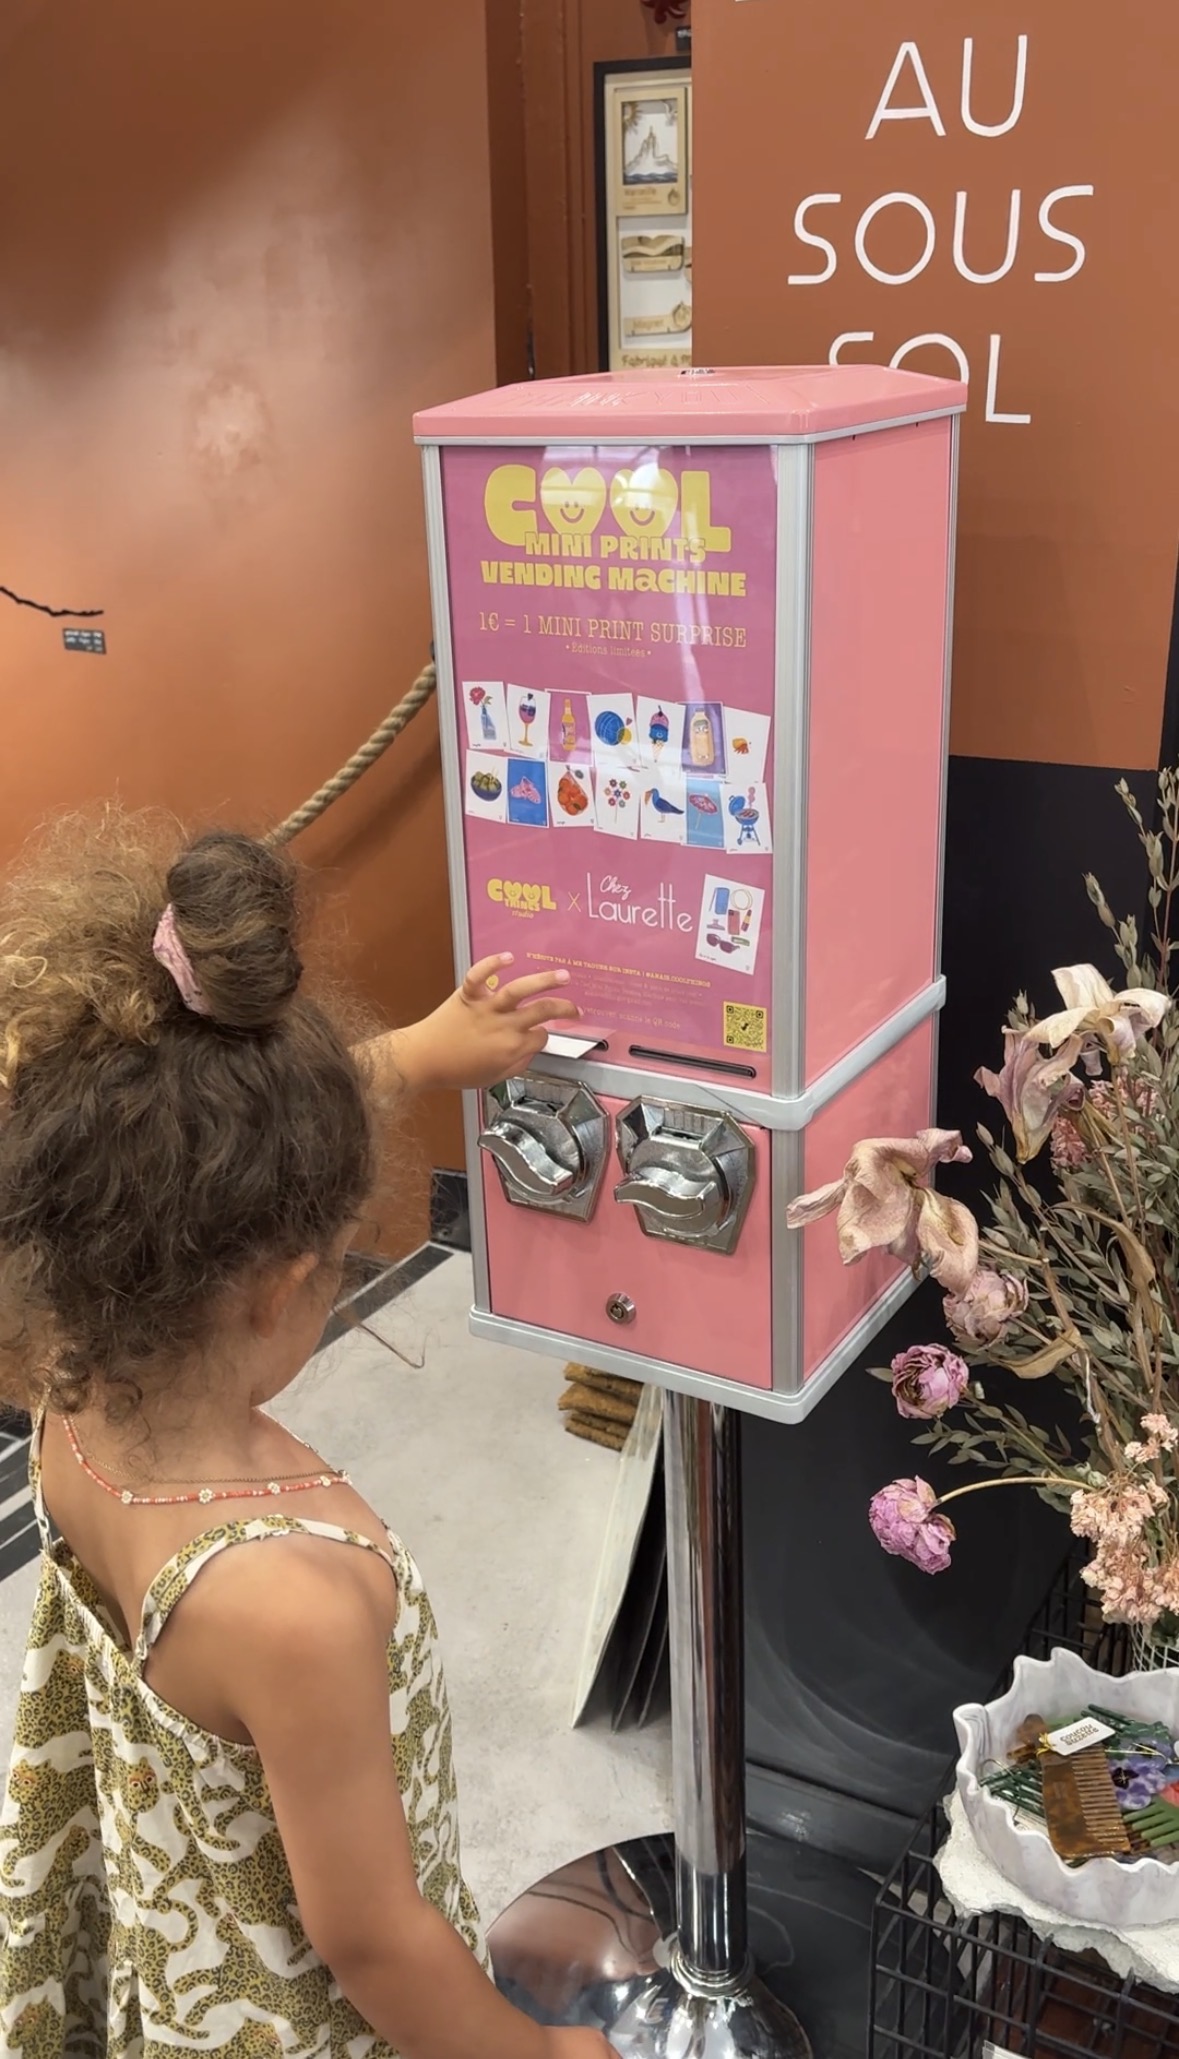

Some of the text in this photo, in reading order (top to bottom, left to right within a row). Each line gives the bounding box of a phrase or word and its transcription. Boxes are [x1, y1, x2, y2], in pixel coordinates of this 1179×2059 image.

[865, 34, 1028, 139] AU
[787, 184, 1094, 285] SOUS
[484, 464, 731, 552] COOL
[525, 532, 706, 563] MINI PRINTS
[480, 560, 601, 590] VENDING
[479, 611, 499, 632] 1€
[523, 614, 531, 634] 1
[538, 615, 581, 637] MINI
[588, 619, 644, 641] PRINT
[650, 623, 747, 648] SURPRISE
[487, 878, 557, 911] COOL
[504, 898, 541, 912] THINGS
[586, 872, 693, 932] Laurette
[599, 875, 632, 900] Chez
